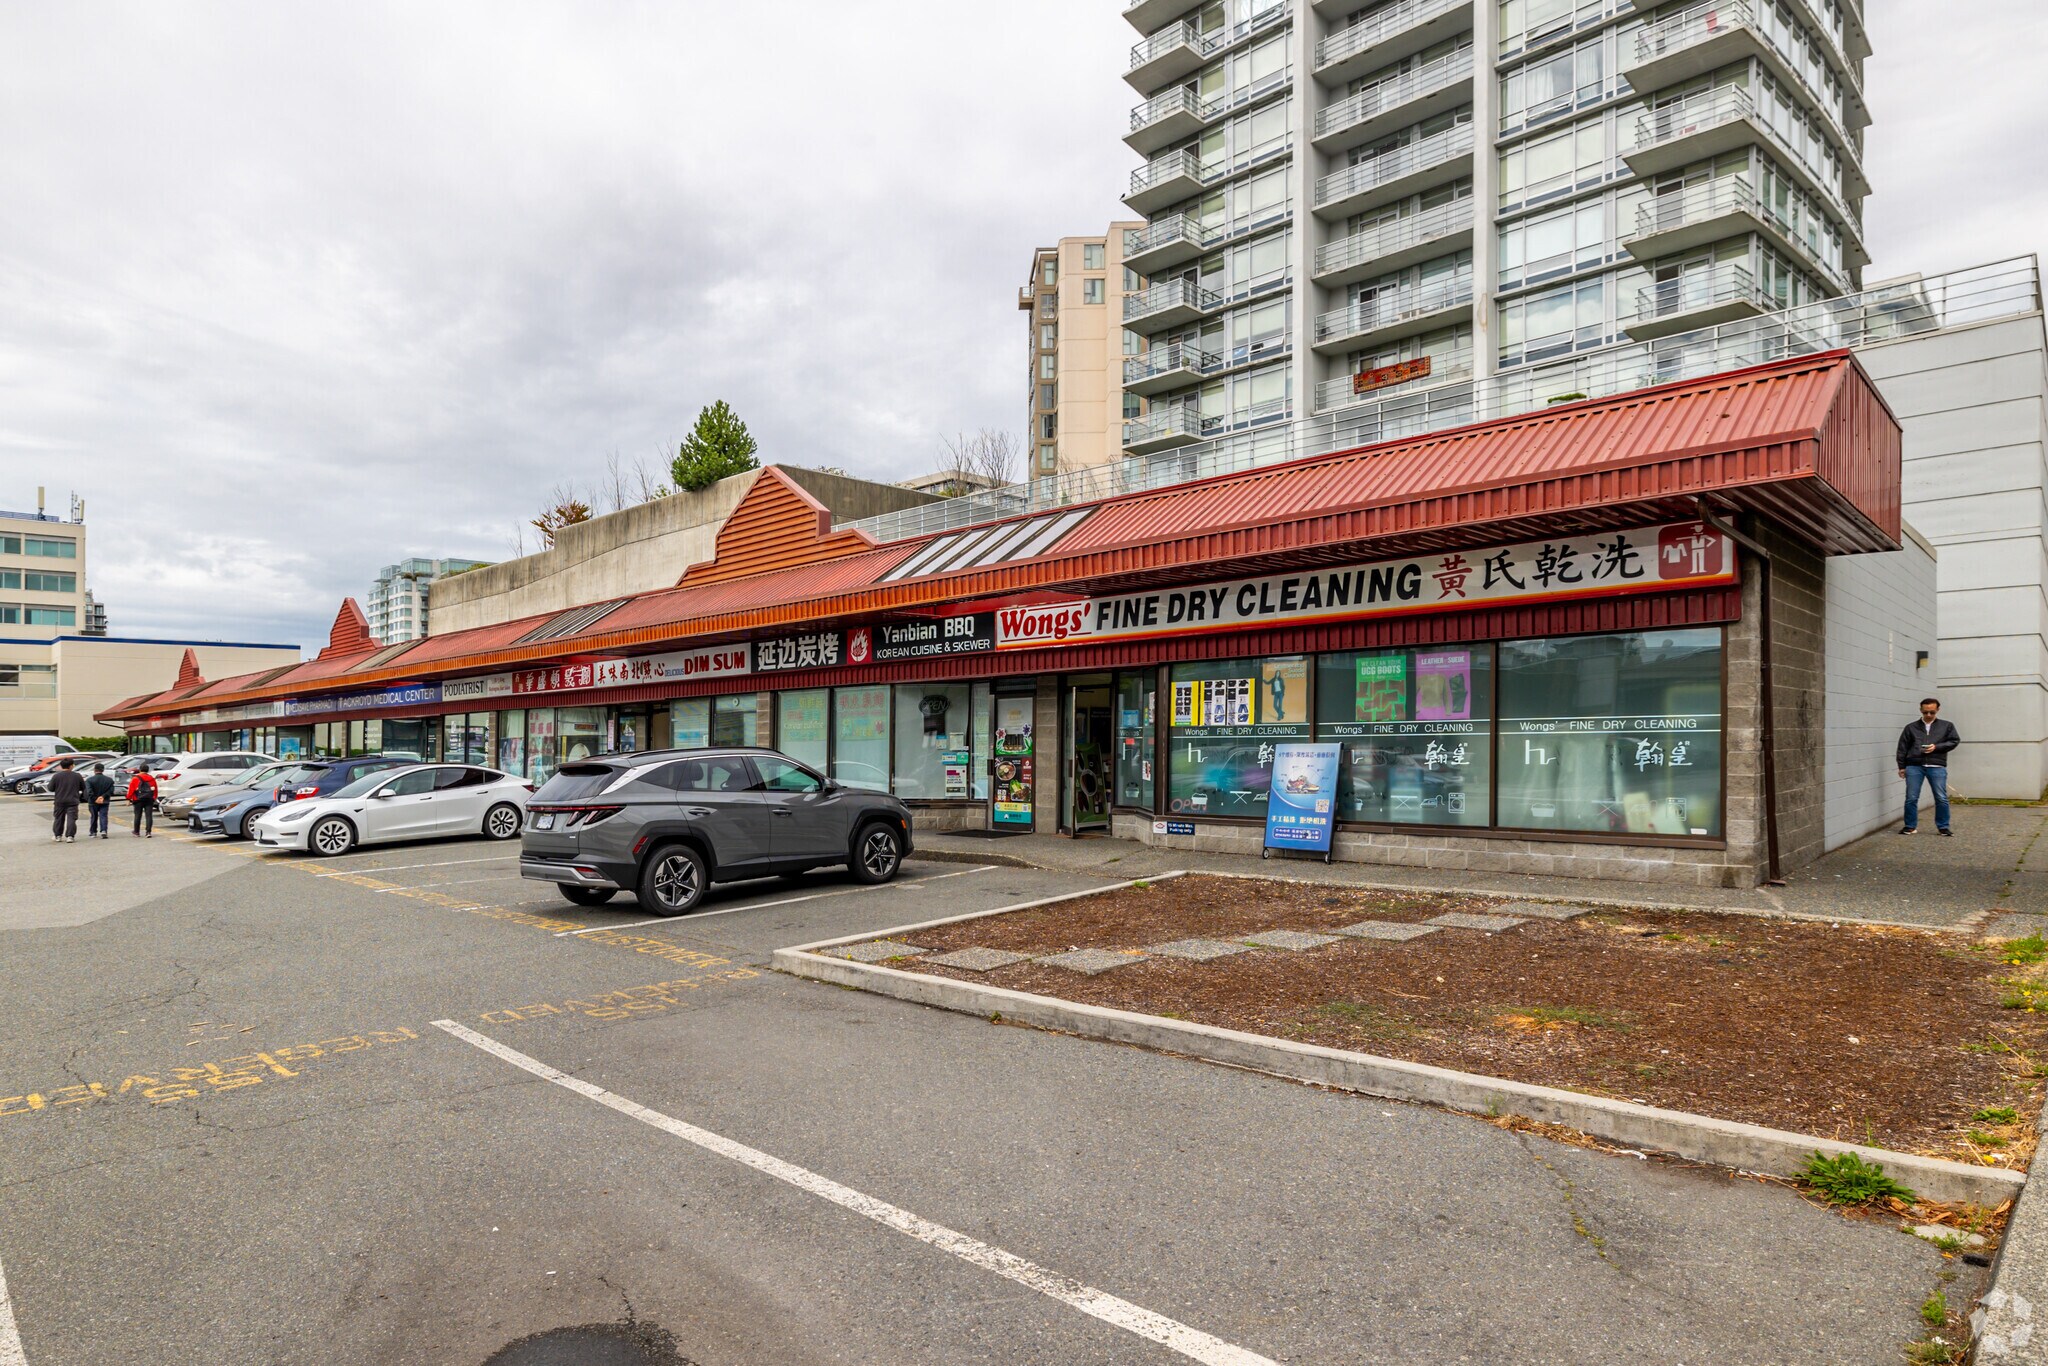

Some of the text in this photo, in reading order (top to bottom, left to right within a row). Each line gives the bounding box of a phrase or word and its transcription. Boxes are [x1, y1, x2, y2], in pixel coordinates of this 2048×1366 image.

[1000, 563, 1422, 640] Wongs' FINE DRY CLEANING
[883, 615, 975, 645] Yanbian BBQ
[758, 632, 839, 671] 延边炭烤
[876, 638, 990, 659] KOREAN CUISINE & SKEWER
[684, 650, 745, 675] DIM SUM
[1421, 655, 1465, 665] LEATHER SUEDE
[1361, 665, 1401, 676] UGG BOOTS
[342, 687, 435, 709] ACKROYD MEDICAL CENTER
[444, 680, 485, 697] PODIATRIST
[1185, 727, 1210, 736] Wongs'
[1238, 727, 1253, 735] DRY
[1257, 727, 1297, 735] CLEANING
[1334, 723, 1473, 734] Wongs' FINE DRY CLEANING
[1520, 718, 1697, 731] Wongs' FINE DRY CLEANING
